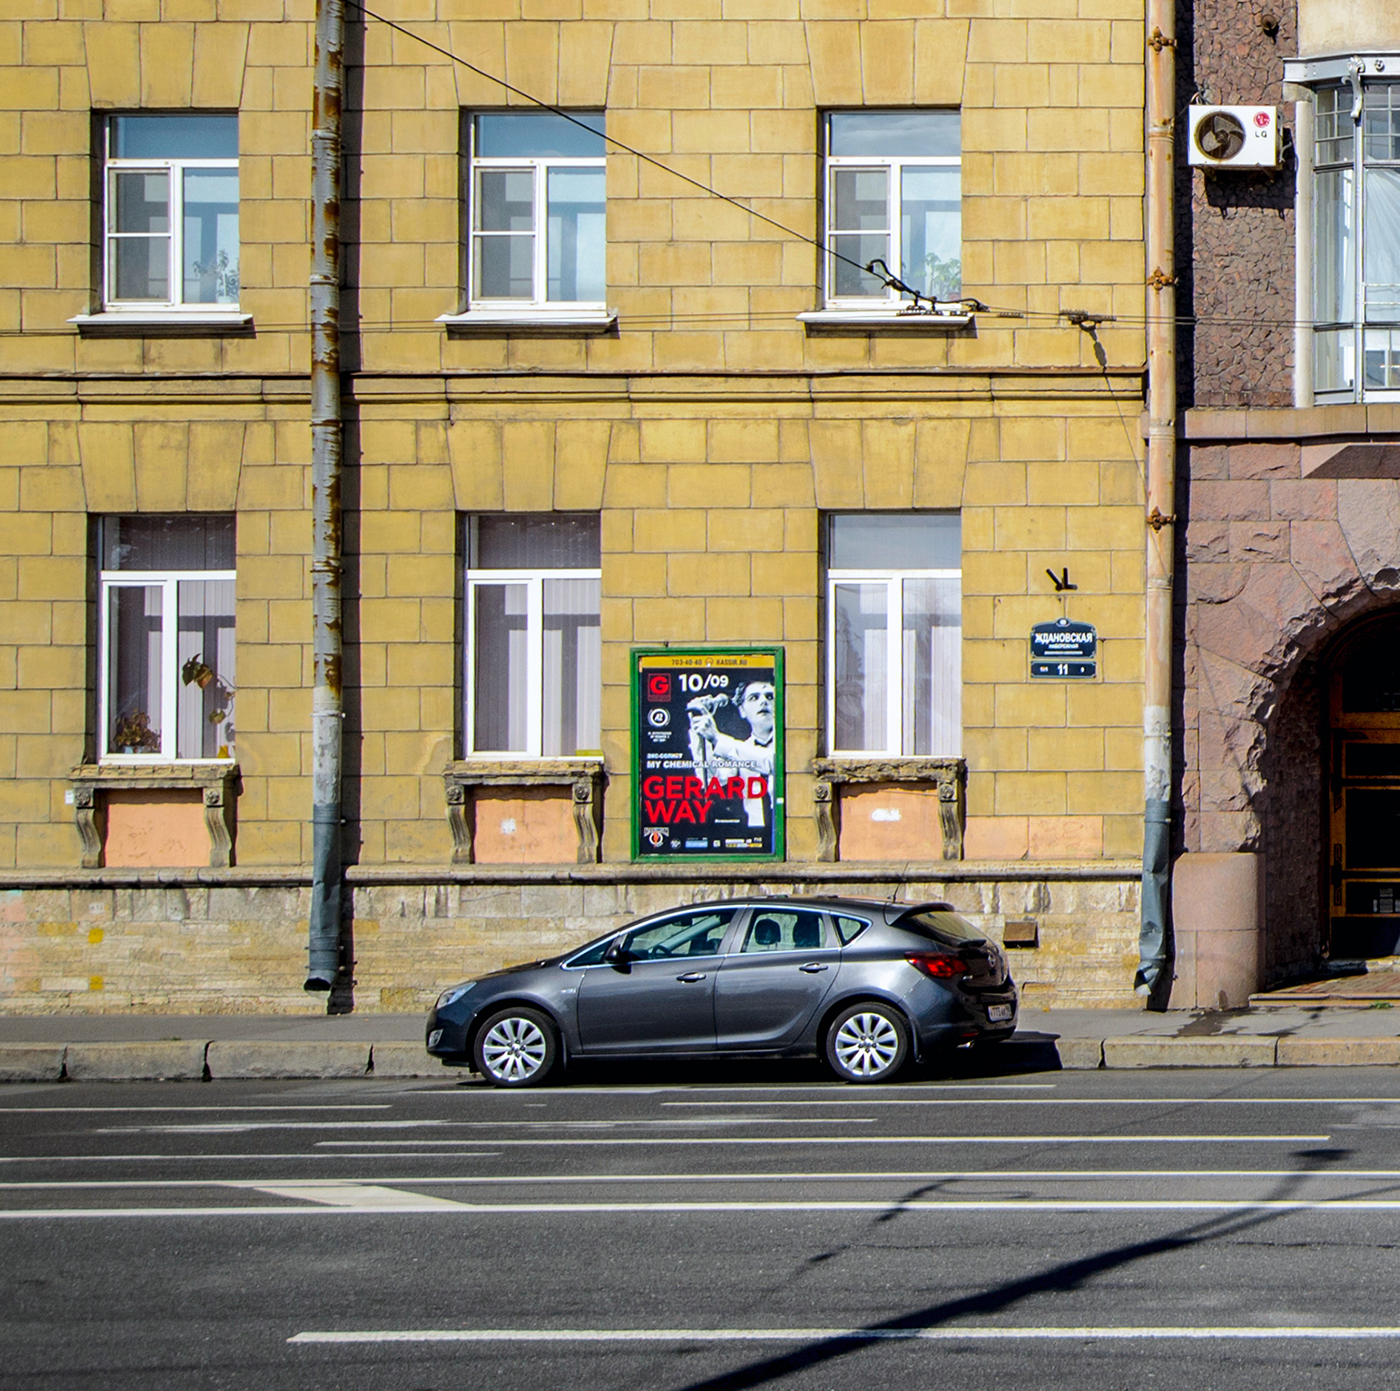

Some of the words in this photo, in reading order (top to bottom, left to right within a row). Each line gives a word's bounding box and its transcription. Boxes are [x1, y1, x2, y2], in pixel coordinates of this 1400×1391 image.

[1255, 130, 1267, 138] LG
[1035, 632, 1093, 645] ЖДАНОВСКАЯ
[1057, 663, 1068, 675] 11
[650, 676, 669, 694] G
[678, 673, 729, 692] 10/09
[647, 760, 661, 768] MY
[663, 760, 709, 768] CHEMICAL
[712, 760, 757, 768] ROMANCE
[643, 775, 768, 799] GERARD
[644, 799, 713, 823] WAY
